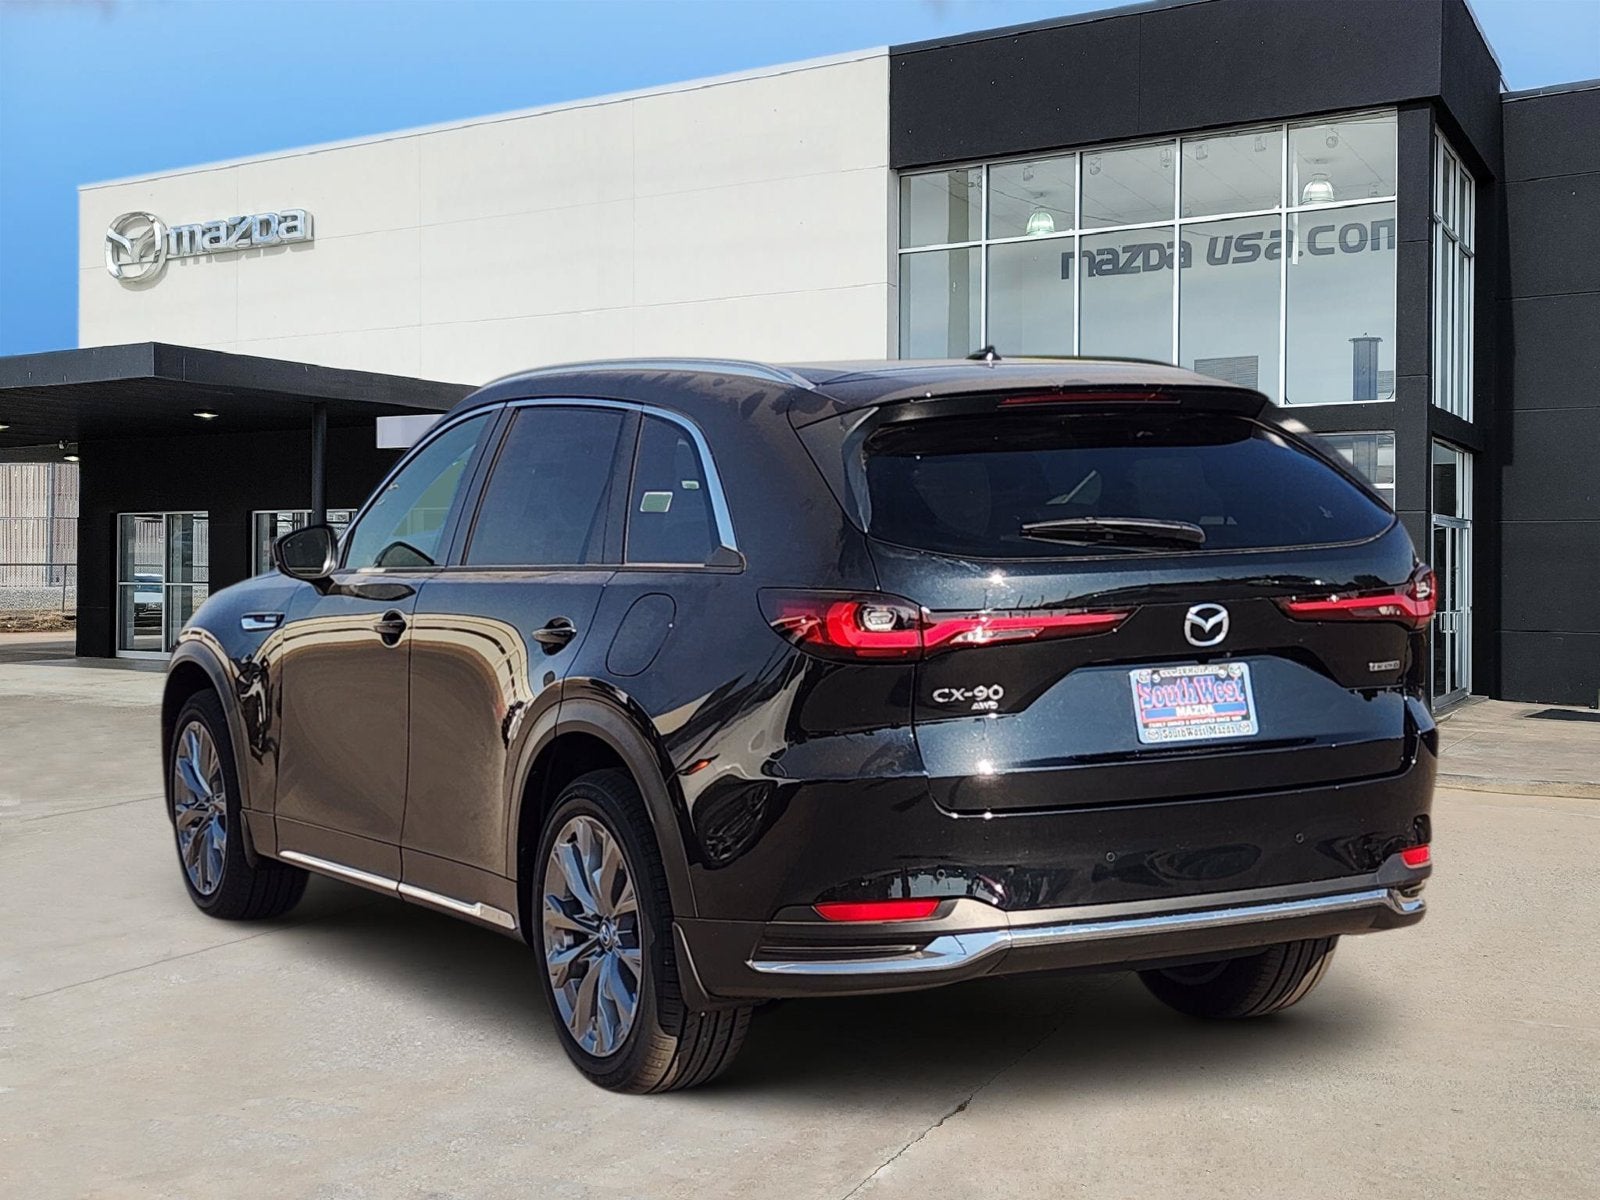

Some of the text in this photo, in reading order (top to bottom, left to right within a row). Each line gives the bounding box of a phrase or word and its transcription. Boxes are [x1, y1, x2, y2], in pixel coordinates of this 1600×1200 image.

[166, 209, 311, 256] mazda
[1061, 240, 1192, 279] mazda
[932, 684, 1004, 702] CX-90
[971, 700, 998, 710] AWD
[1176, 704, 1215, 717] MAZDA
